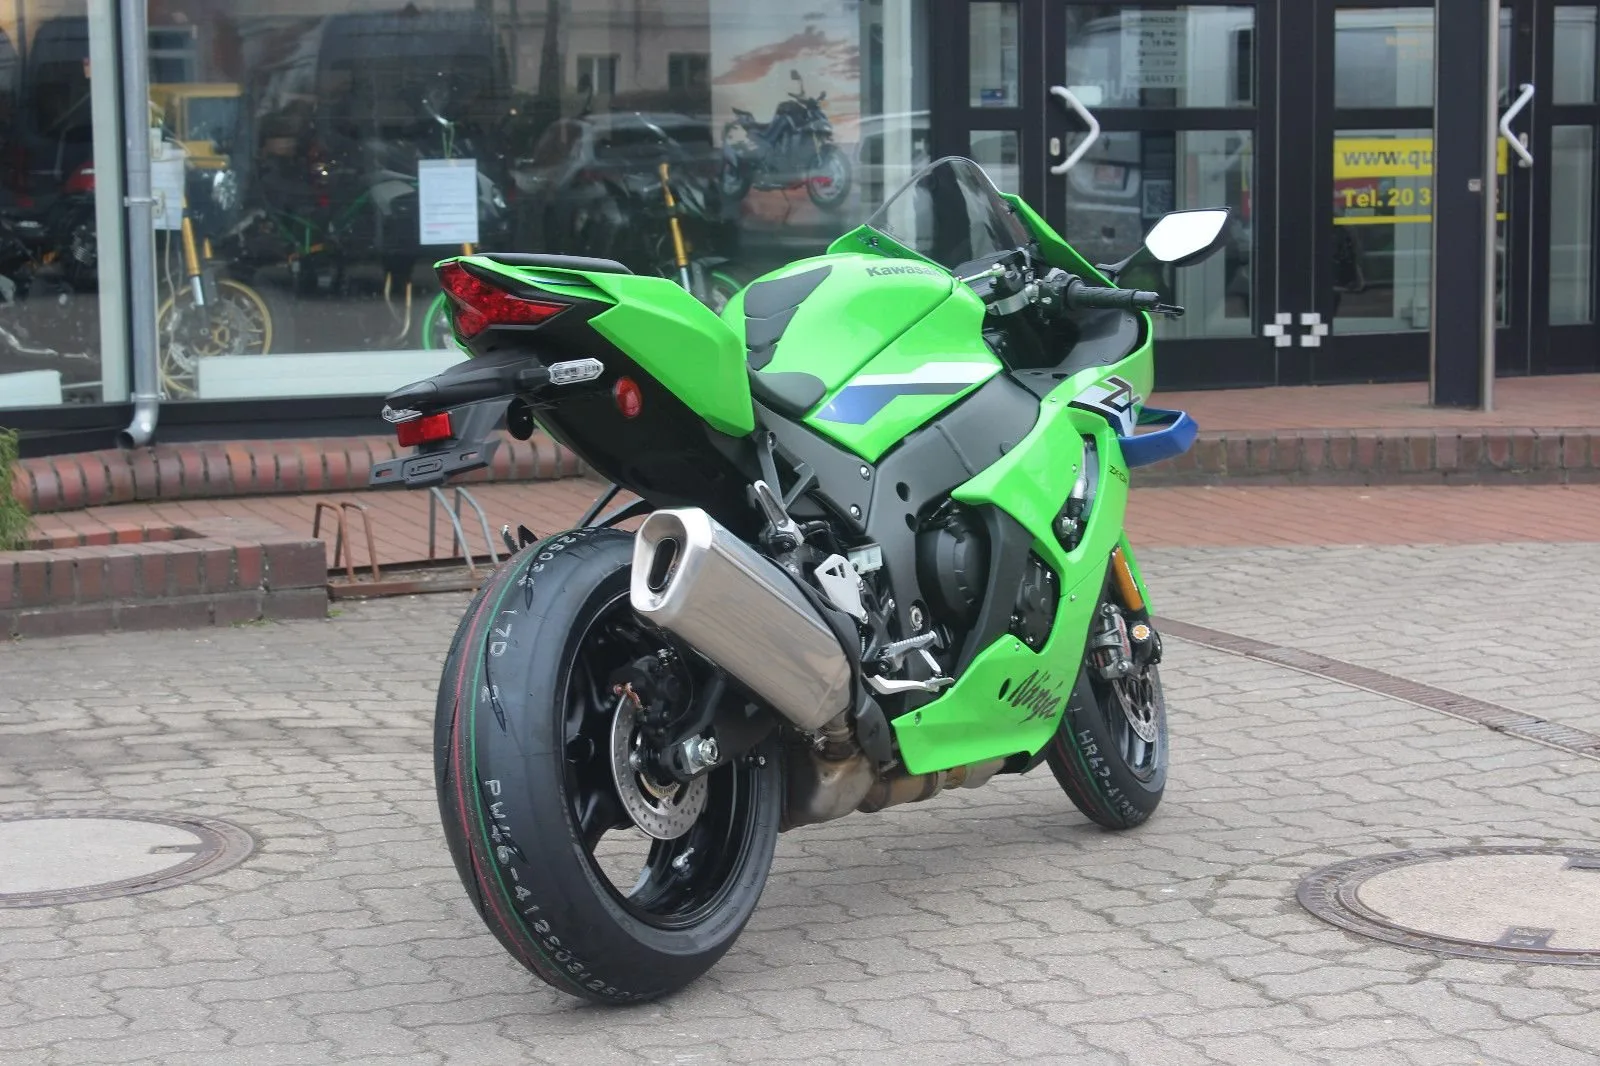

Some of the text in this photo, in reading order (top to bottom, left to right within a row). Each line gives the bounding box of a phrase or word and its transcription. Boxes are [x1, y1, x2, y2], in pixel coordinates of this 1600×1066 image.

[1343, 150, 1433, 169] www.qu
[1342, 188, 1384, 207] Tel.
[1388, 188, 1414, 206] 20
[1419, 187, 1432, 206] 3
[866, 265, 945, 277] Kawasa
[1007, 669, 1062, 724] Ninja
